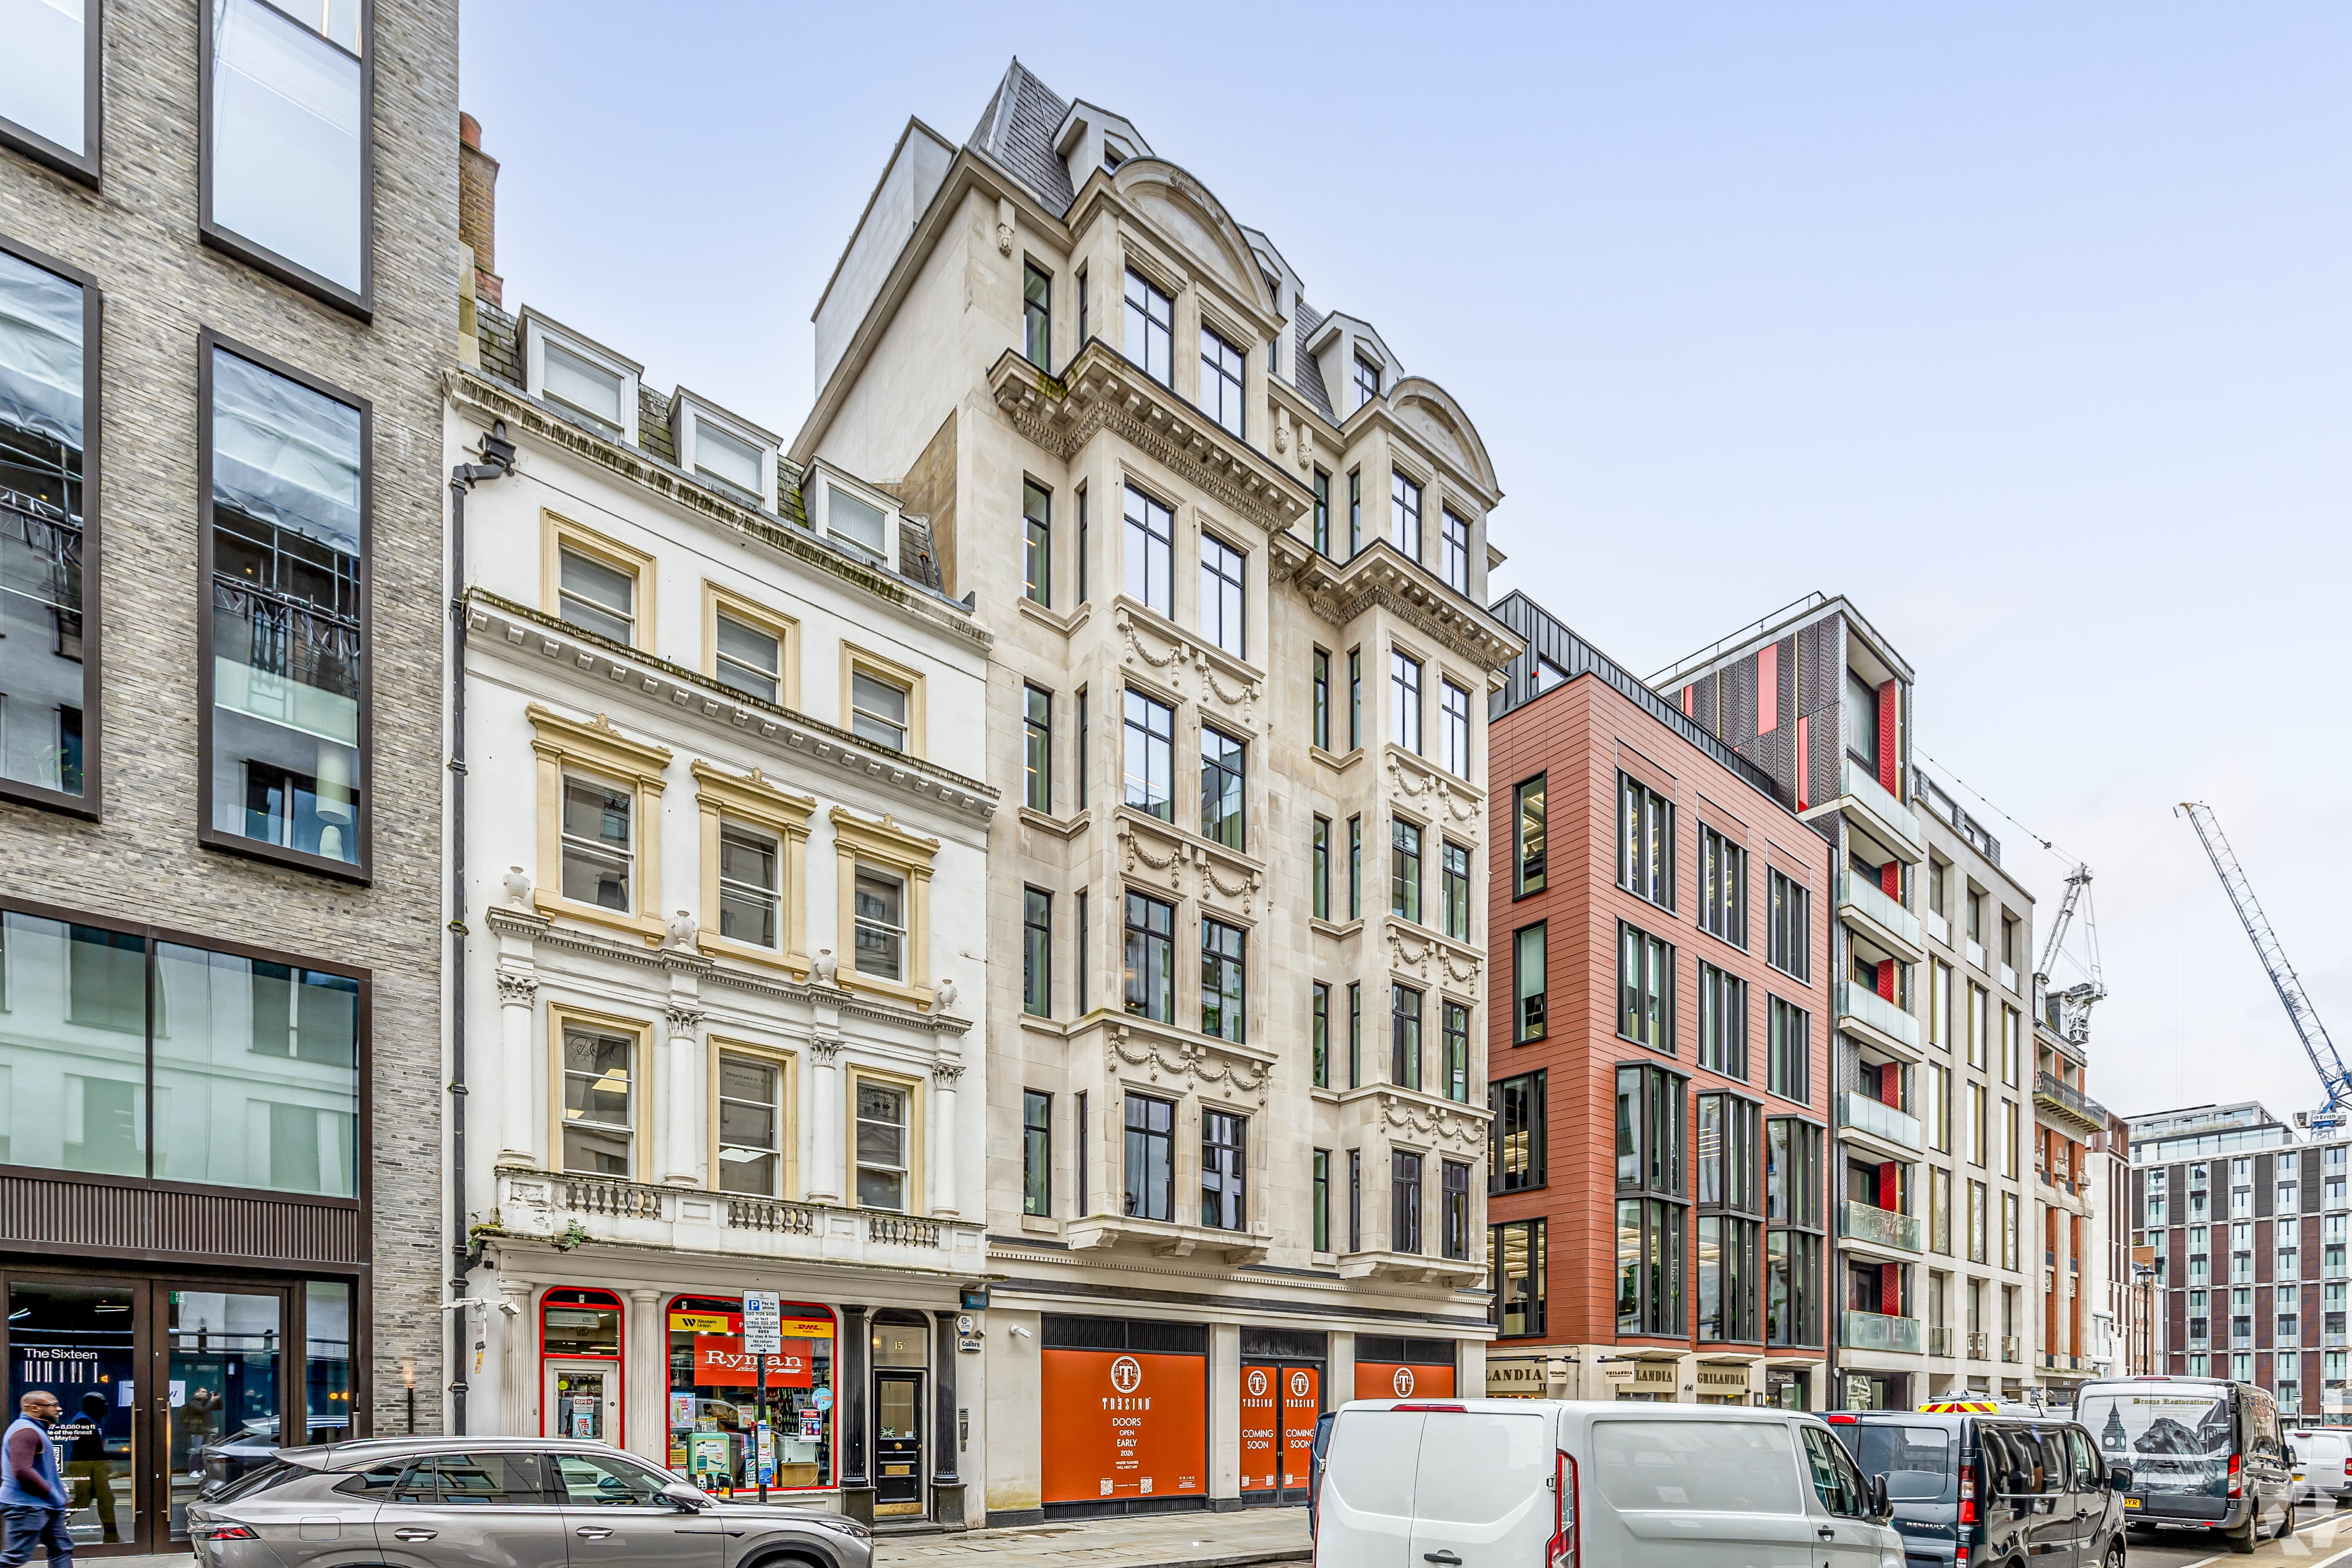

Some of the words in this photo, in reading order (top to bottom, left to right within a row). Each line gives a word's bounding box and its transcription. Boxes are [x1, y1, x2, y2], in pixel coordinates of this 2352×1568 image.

[2286, 992, 2301, 1013] WOLFF
[725, 1071, 758, 1082] MONTAGUE
[24, 1348, 49, 1358] The
[51, 1349, 98, 1359] Sixteen
[705, 1350, 803, 1368] Ryman
[1486, 1368, 1543, 1381] LANDIA
[1635, 1370, 1673, 1383] LANDIA
[1697, 1373, 1745, 1386] GRILANDIA
[1112, 1418, 1142, 1426] DOORS
[1242, 1429, 1274, 1438] COMING
[1286, 1429, 1315, 1437] COMING
[1117, 1439, 1138, 1447] EARLY
[1247, 1441, 1269, 1449] SOON
[1290, 1440, 1311, 1448] SOON
